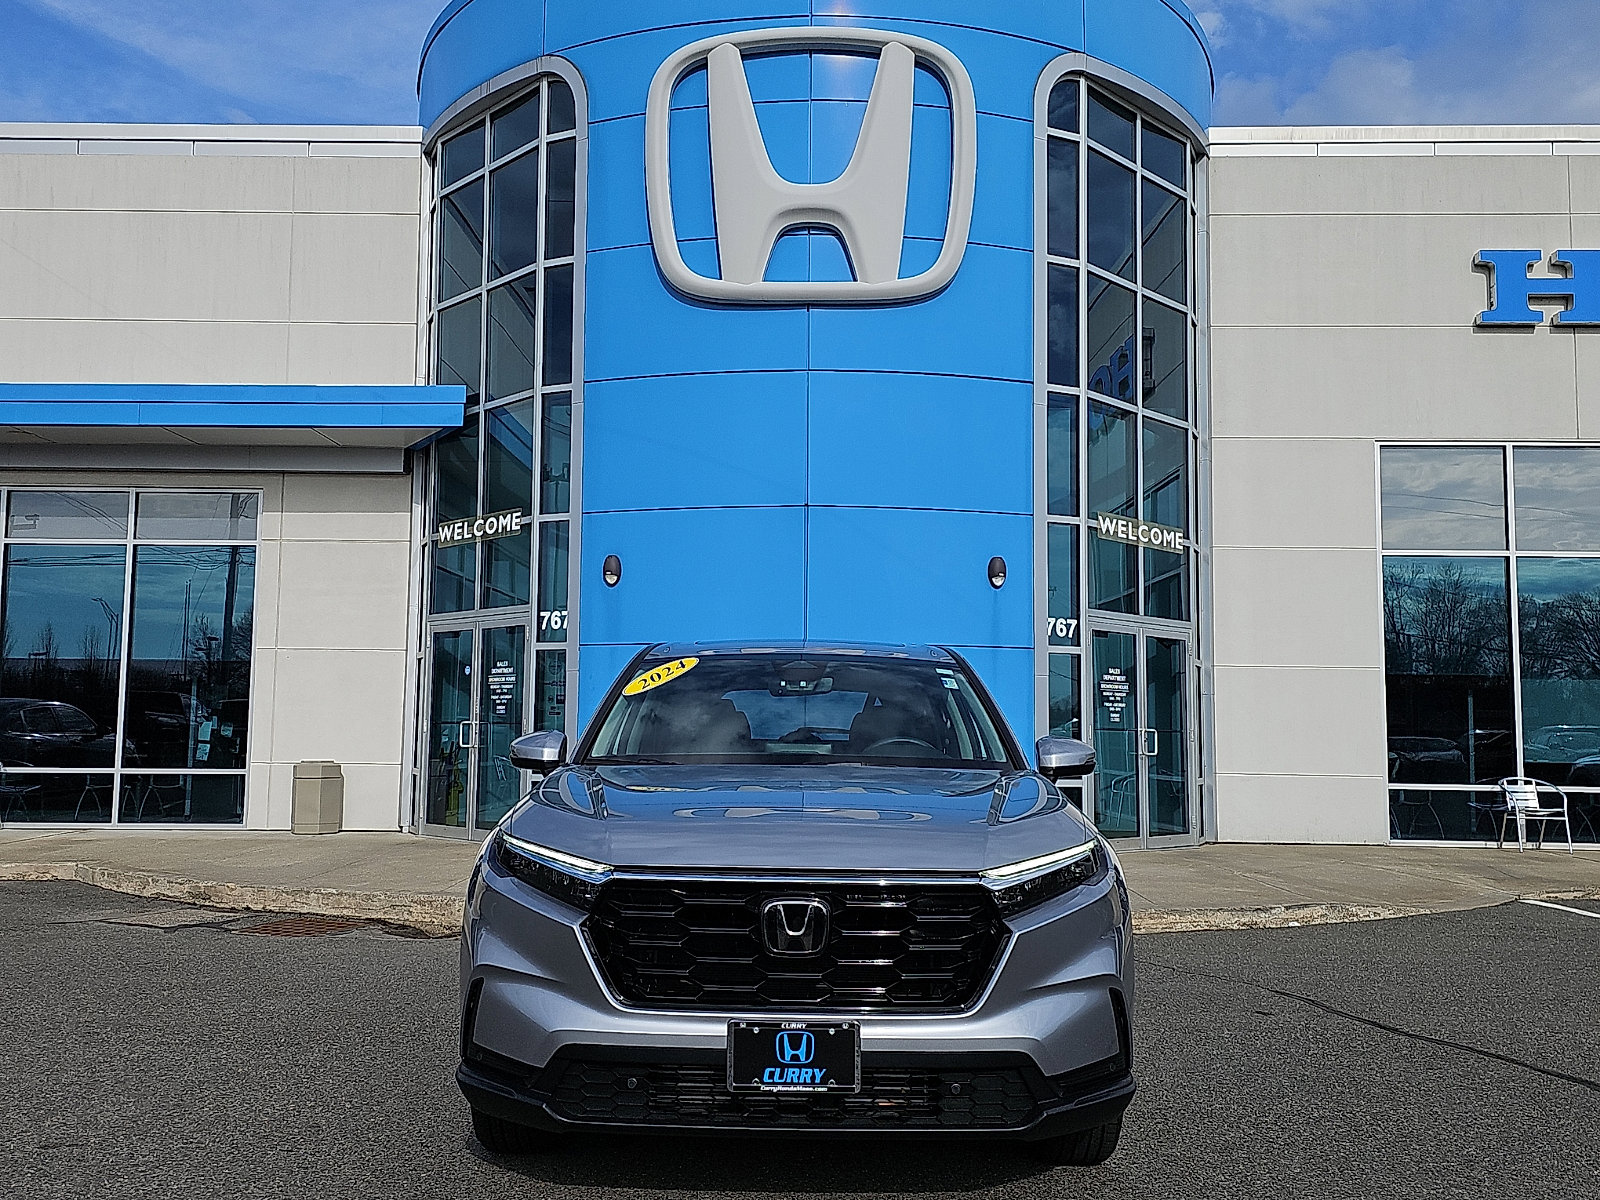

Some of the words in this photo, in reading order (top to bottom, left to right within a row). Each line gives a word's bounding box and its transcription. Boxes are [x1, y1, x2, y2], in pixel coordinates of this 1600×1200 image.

[438, 511, 522, 543] WELCOME
[1097, 515, 1184, 550] WELCOME
[540, 610, 569, 630] 767
[1047, 617, 1078, 638] 767
[637, 659, 688, 690] 2024
[763, 1067, 827, 1084] CURRY
